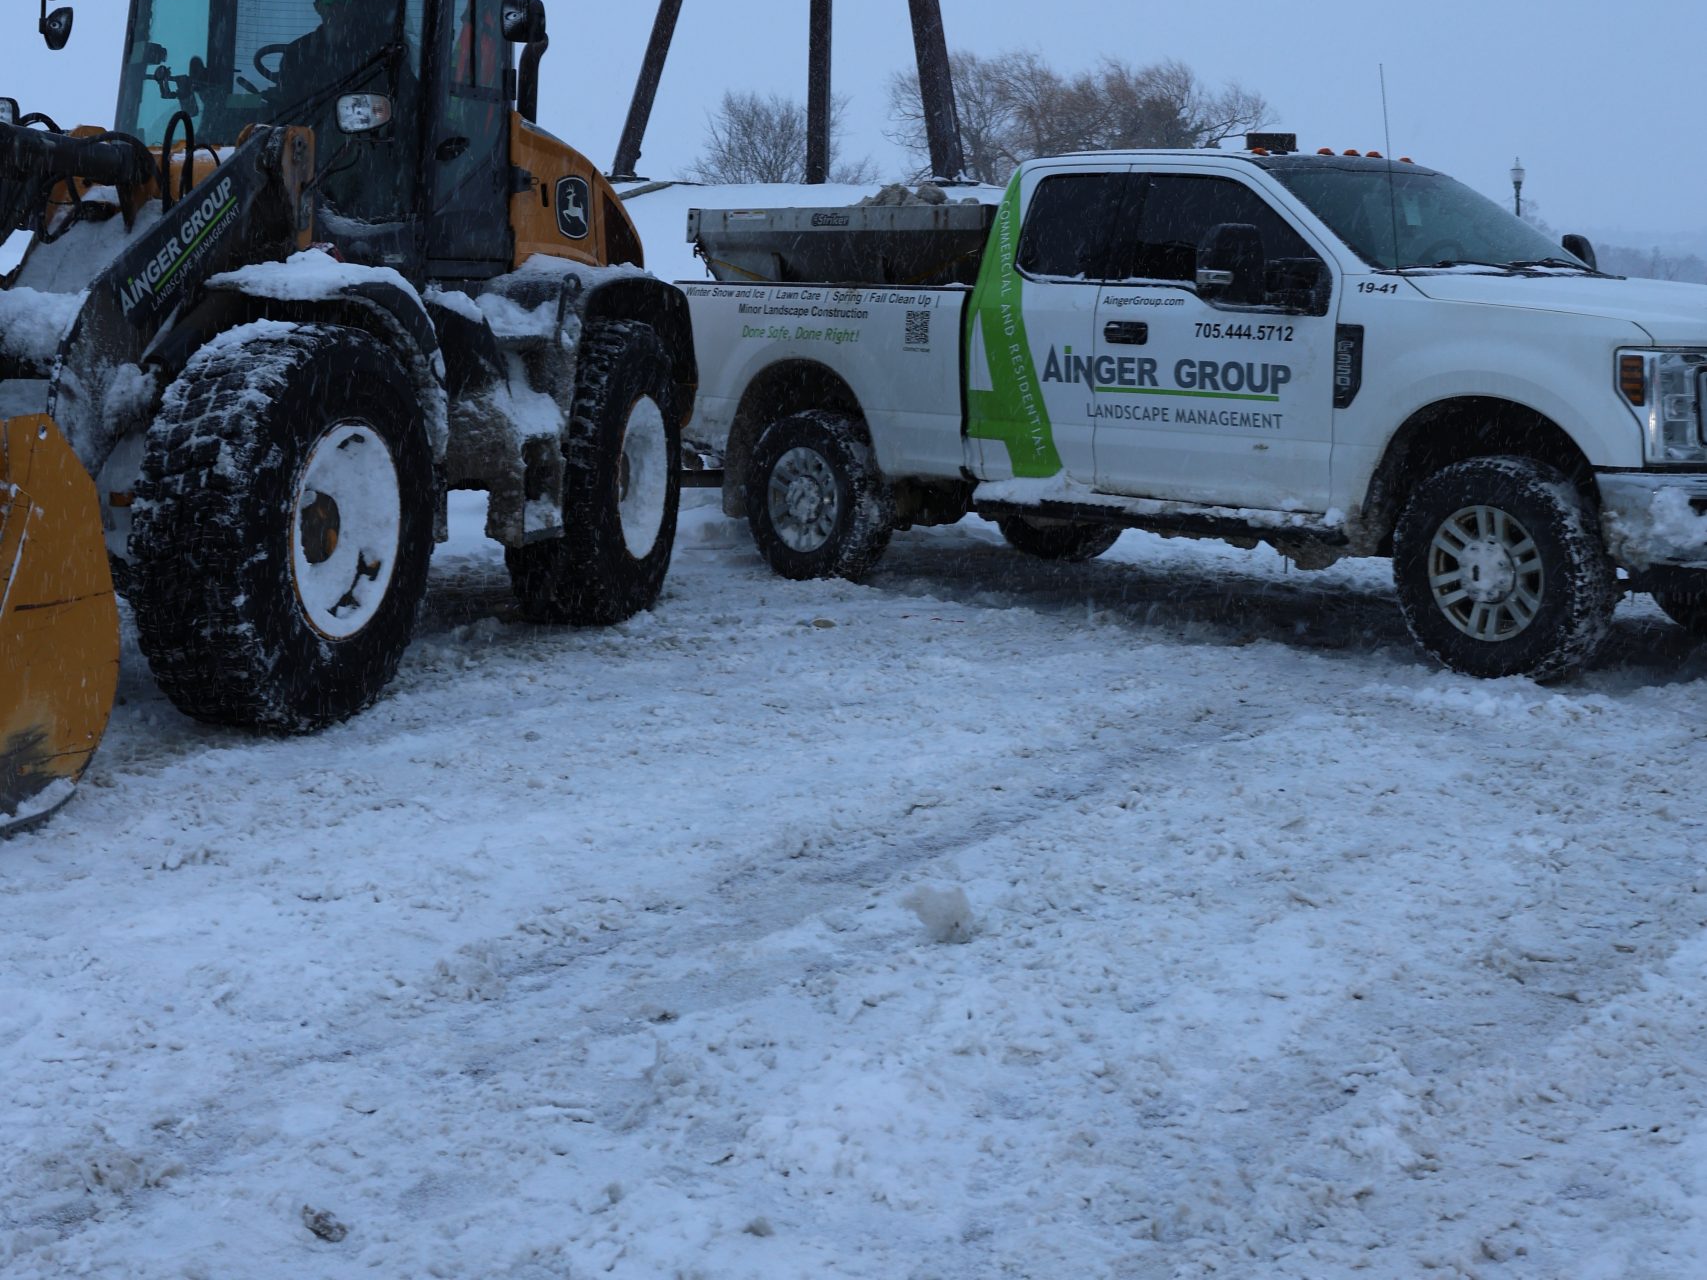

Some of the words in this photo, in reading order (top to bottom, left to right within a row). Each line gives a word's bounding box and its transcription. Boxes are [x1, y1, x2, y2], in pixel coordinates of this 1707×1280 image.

[181, 176, 232, 244] GROUP
[151, 259, 193, 311] LANDSCAPE
[192, 203, 242, 260] MANAGEMENT
[1000, 200, 1012, 297] COMMERCIAL
[686, 286, 711, 297] Winter
[711, 287, 735, 297] Snow
[735, 288, 753, 298] and
[752, 289, 765, 299] Ice
[775, 290, 799, 300] Lawn
[801, 290, 821, 301] Care
[832, 291, 863, 304] Spring
[869, 292, 886, 303] Fall
[888, 293, 916, 305] Clean
[917, 294, 931, 307] Up
[1103, 296, 1185, 307] AingerGroup.com
[1357, 281, 1398, 294] 19-41
[738, 303, 763, 315] Minor
[762, 304, 809, 318] Landscape
[810, 306, 869, 319] Construction
[1000, 304, 1015, 336] AND
[742, 325, 766, 339] Done
[767, 325, 792, 341] Safe,
[795, 326, 821, 340] Done
[824, 327, 860, 344] Right!
[1195, 322, 1294, 342] 705.444.5712
[1174, 358, 1292, 395] GROUP
[1008, 343, 1046, 456] RESIDENTIAL
[1086, 402, 1169, 423] LANDSCAPE
[1175, 408, 1284, 430] MANAGEMENT
